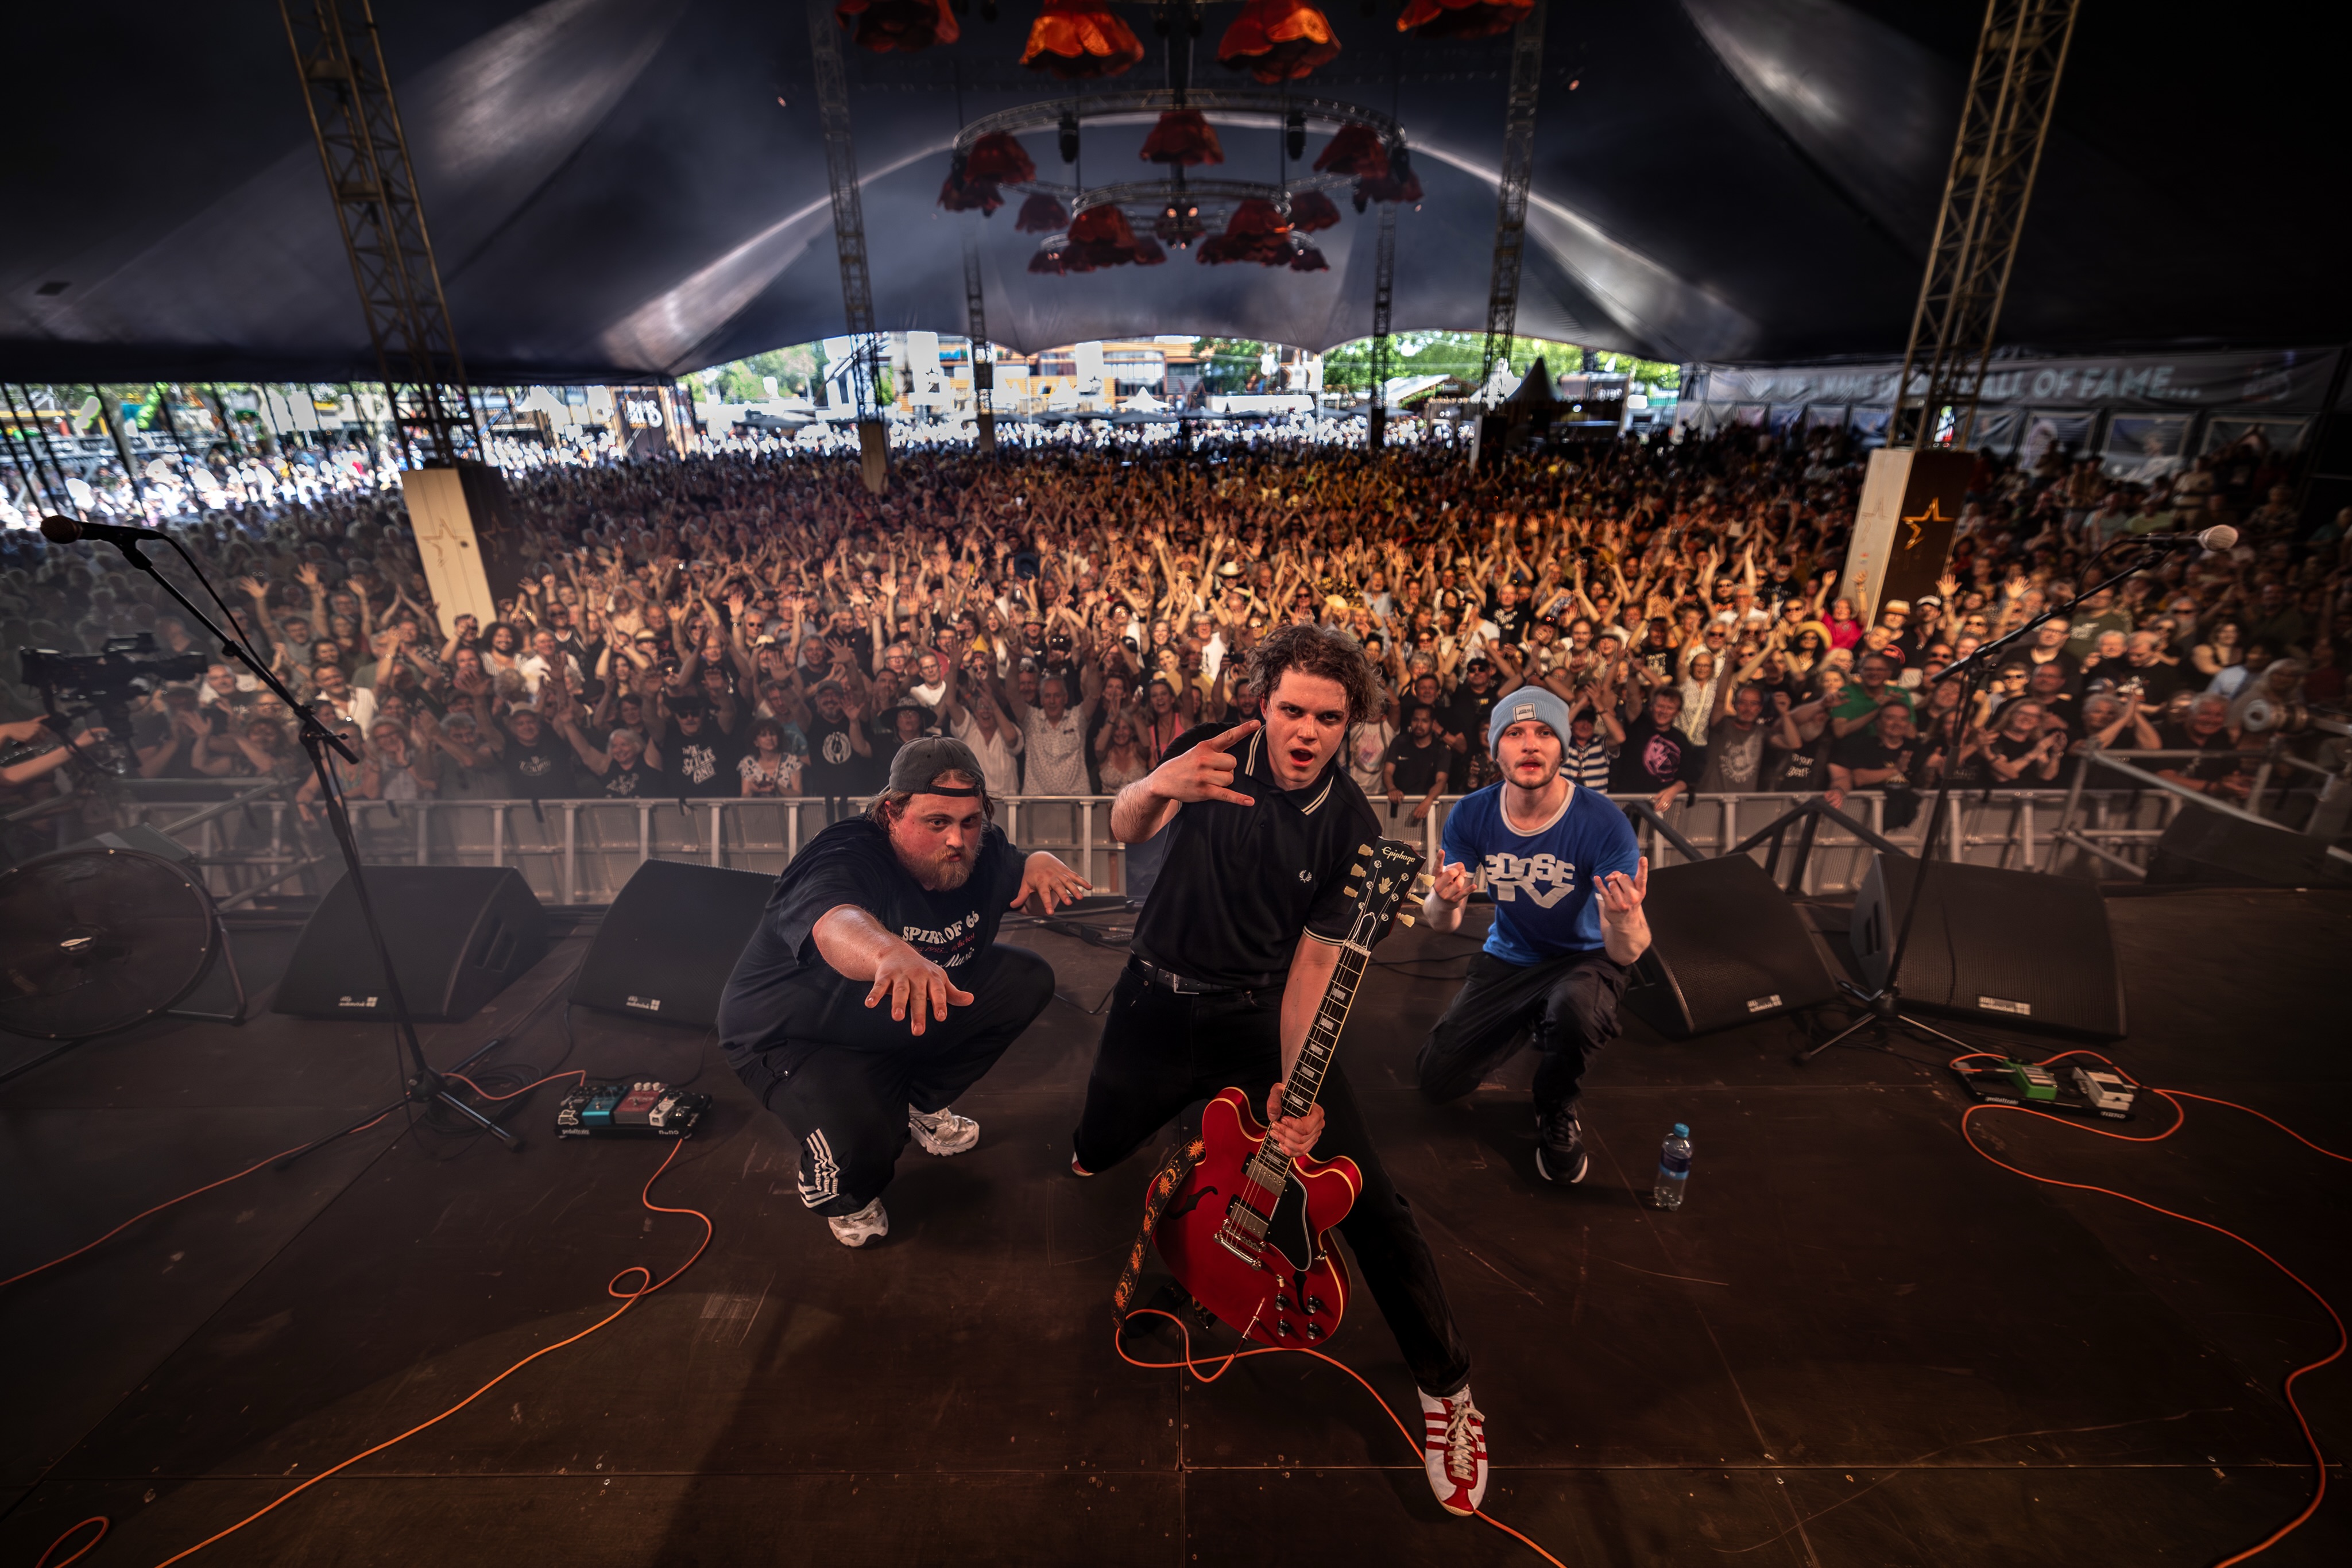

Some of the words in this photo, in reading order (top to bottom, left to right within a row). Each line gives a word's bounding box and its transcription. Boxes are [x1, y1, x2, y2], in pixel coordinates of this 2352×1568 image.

[2034, 369, 2074, 399] OF
[1382, 846, 1415, 865] Epiphone
[903, 926, 947, 944] SPIR
[944, 920, 962, 940] OF
